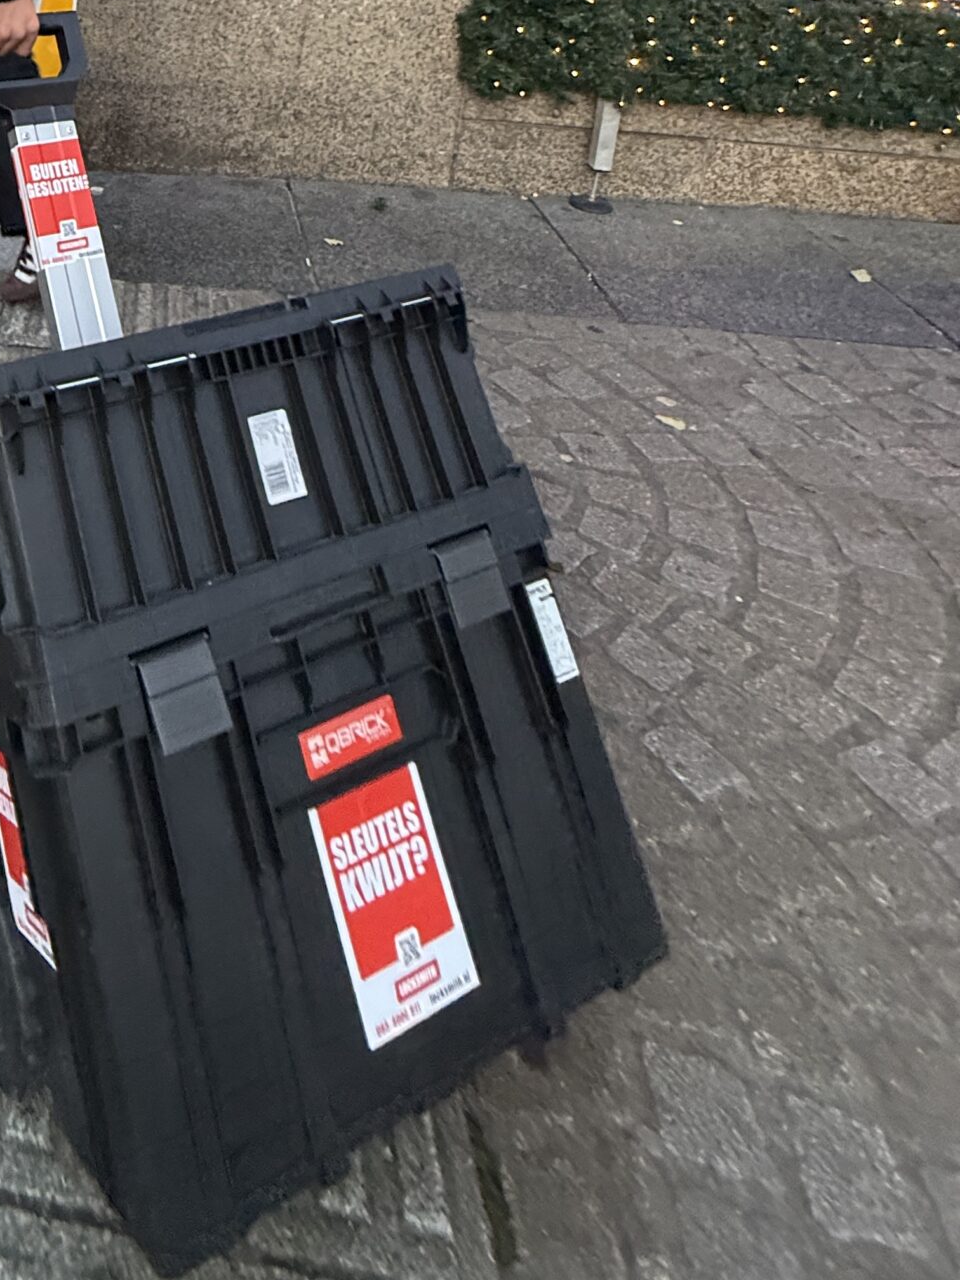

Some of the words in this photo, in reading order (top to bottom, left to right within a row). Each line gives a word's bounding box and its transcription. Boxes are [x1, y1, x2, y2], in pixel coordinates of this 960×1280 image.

[29, 158, 80, 182] BUITEN
[325, 709, 392, 754] QBRICK
[329, 801, 421, 870] SLEUTELS
[339, 835, 429, 913] KWIJT?
